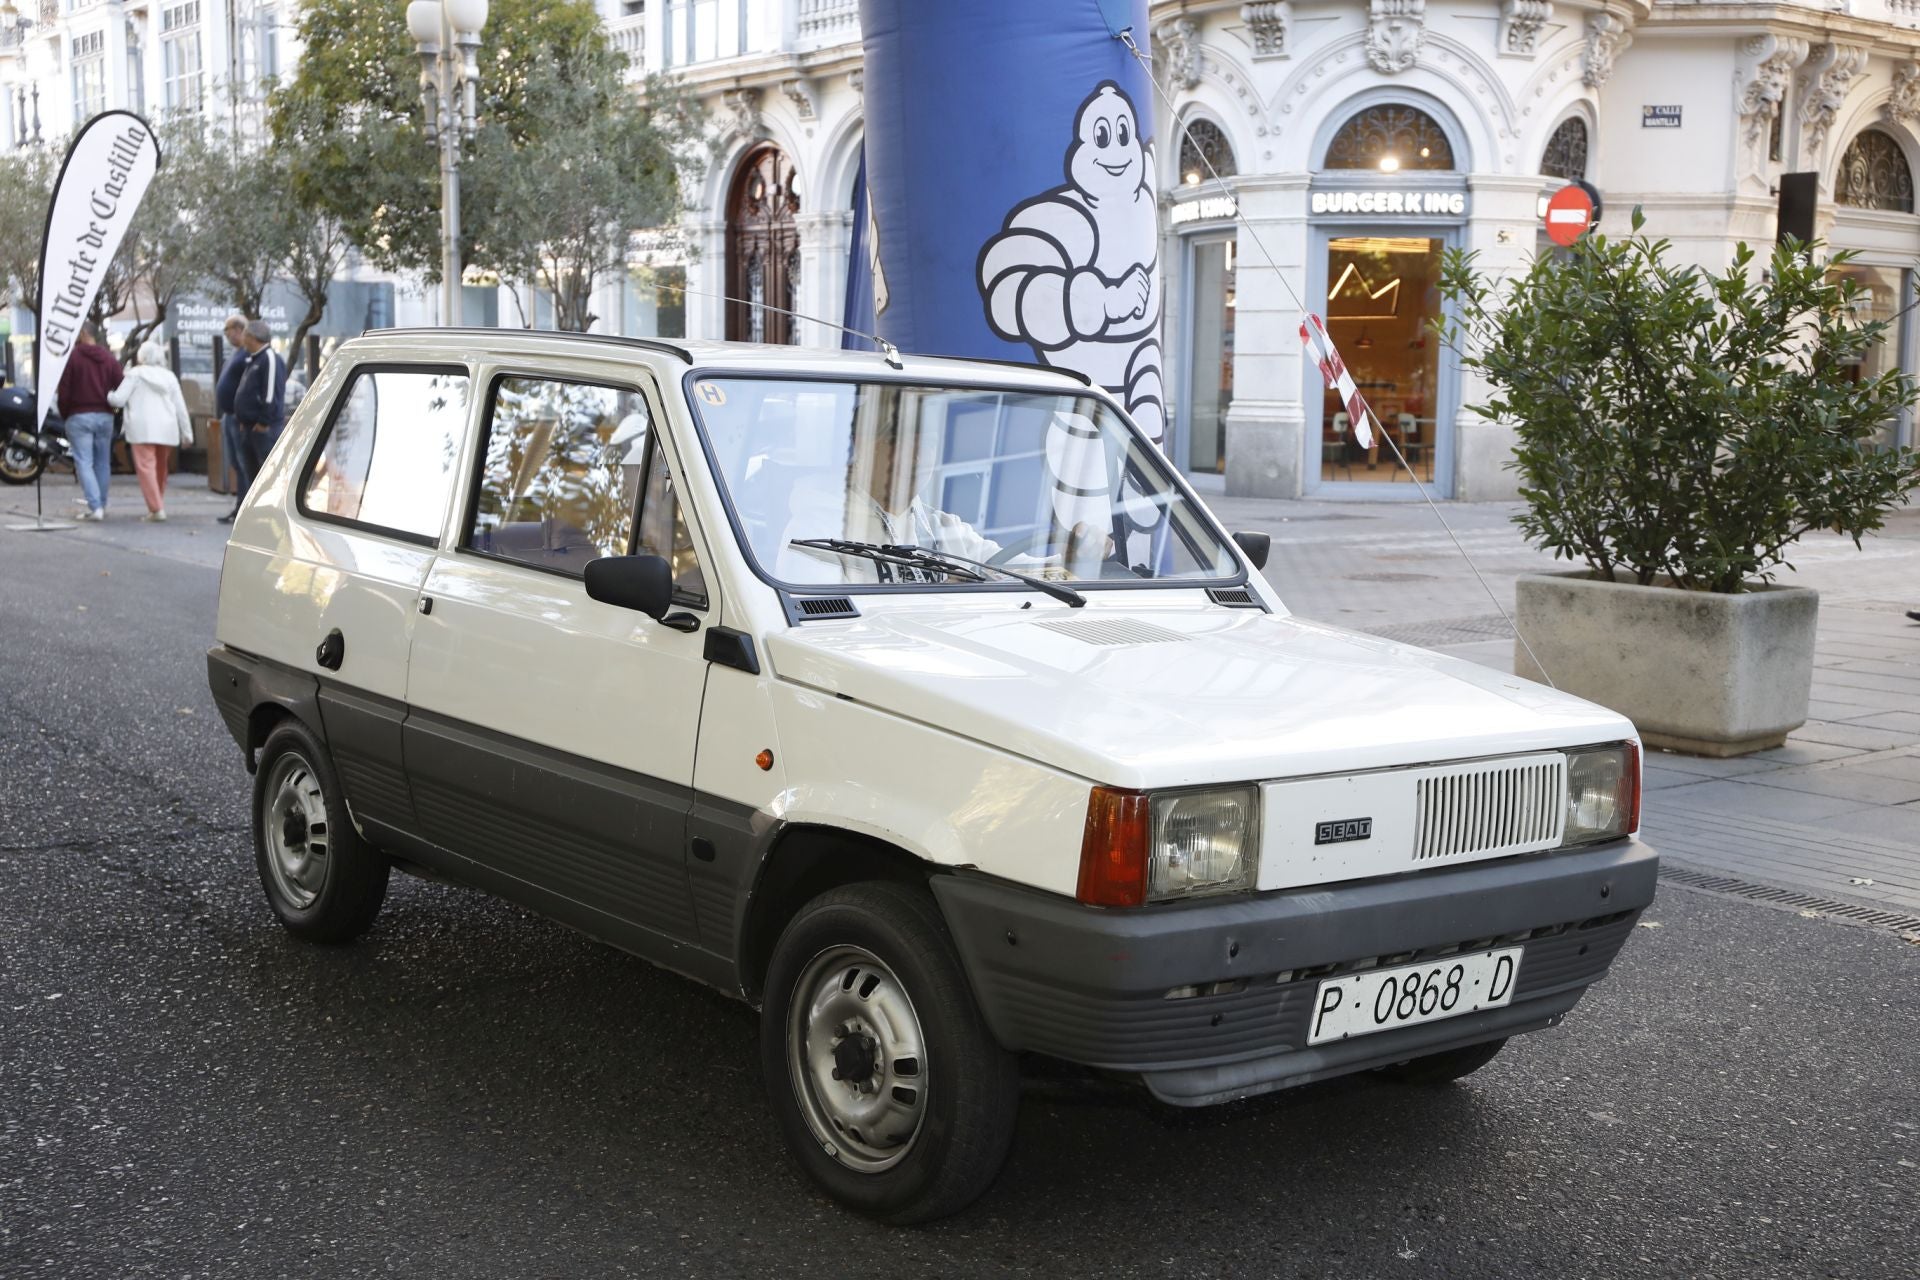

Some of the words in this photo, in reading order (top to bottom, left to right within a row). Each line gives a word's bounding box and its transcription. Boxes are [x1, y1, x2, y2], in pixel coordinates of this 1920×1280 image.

[90, 127, 147, 220] Castilla
[1312, 192, 1403, 212] BURGER
[1404, 192, 1464, 213] KING
[76, 221, 108, 249] de
[51, 250, 97, 319] Norte
[176, 303, 209, 317] Todo
[177, 318, 224, 330] cuando
[45, 320, 75, 358] El
[1319, 819, 1371, 841] SEAT
